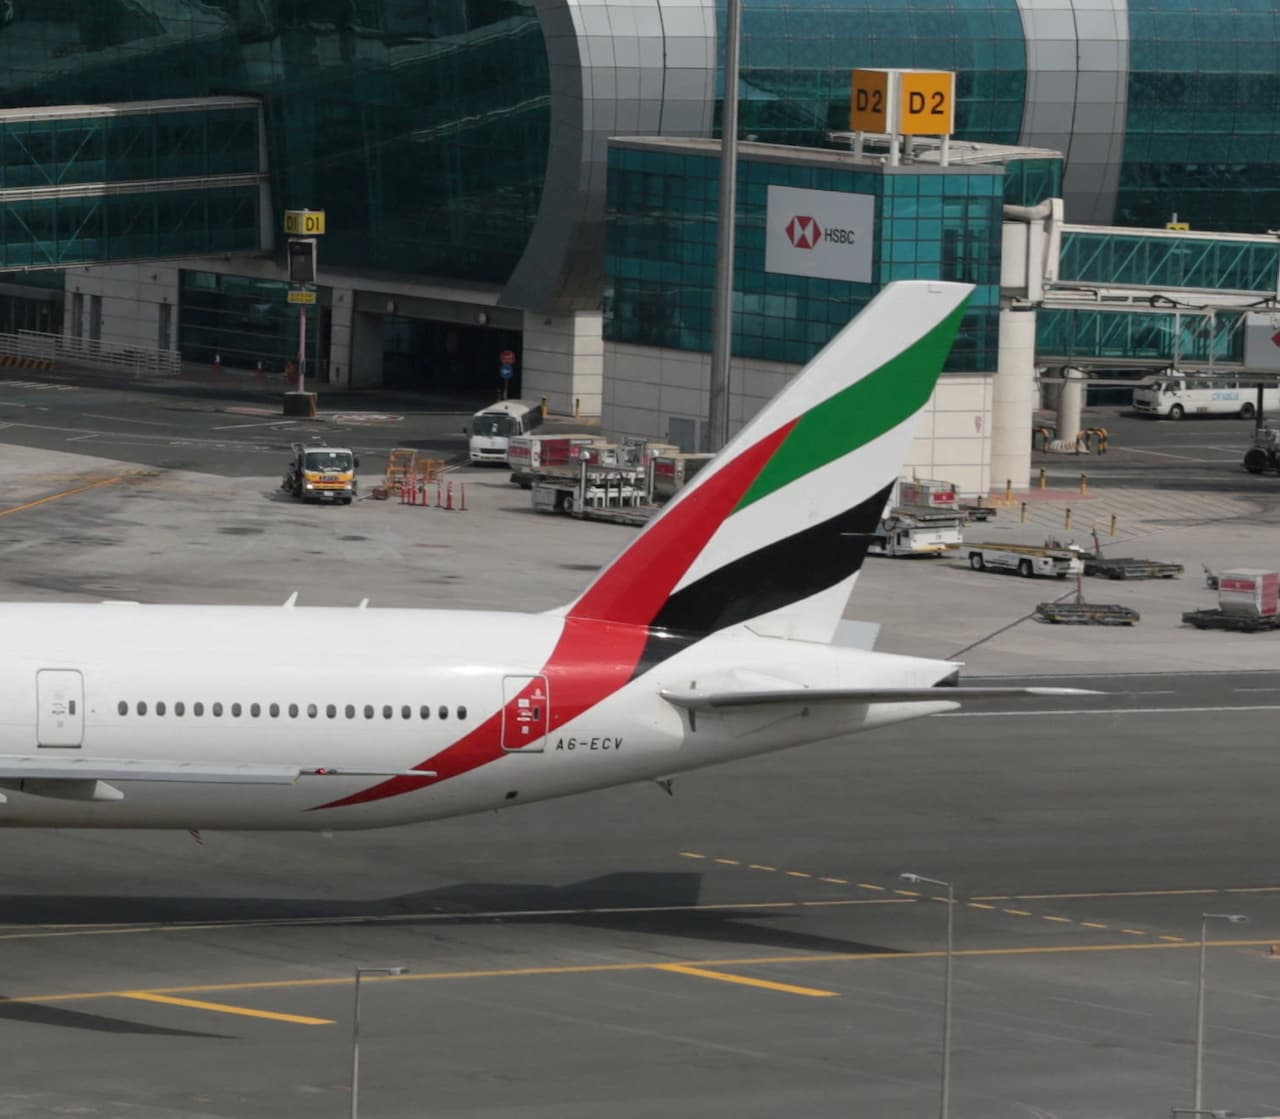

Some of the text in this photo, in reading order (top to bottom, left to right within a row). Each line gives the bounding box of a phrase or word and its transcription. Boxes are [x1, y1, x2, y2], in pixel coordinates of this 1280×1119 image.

[857, 89, 882, 113] D2
[909, 91, 945, 115] D2
[305, 216, 320, 232] D1
[824, 228, 855, 245] HSBC
[555, 737, 624, 751] A6-ECV
